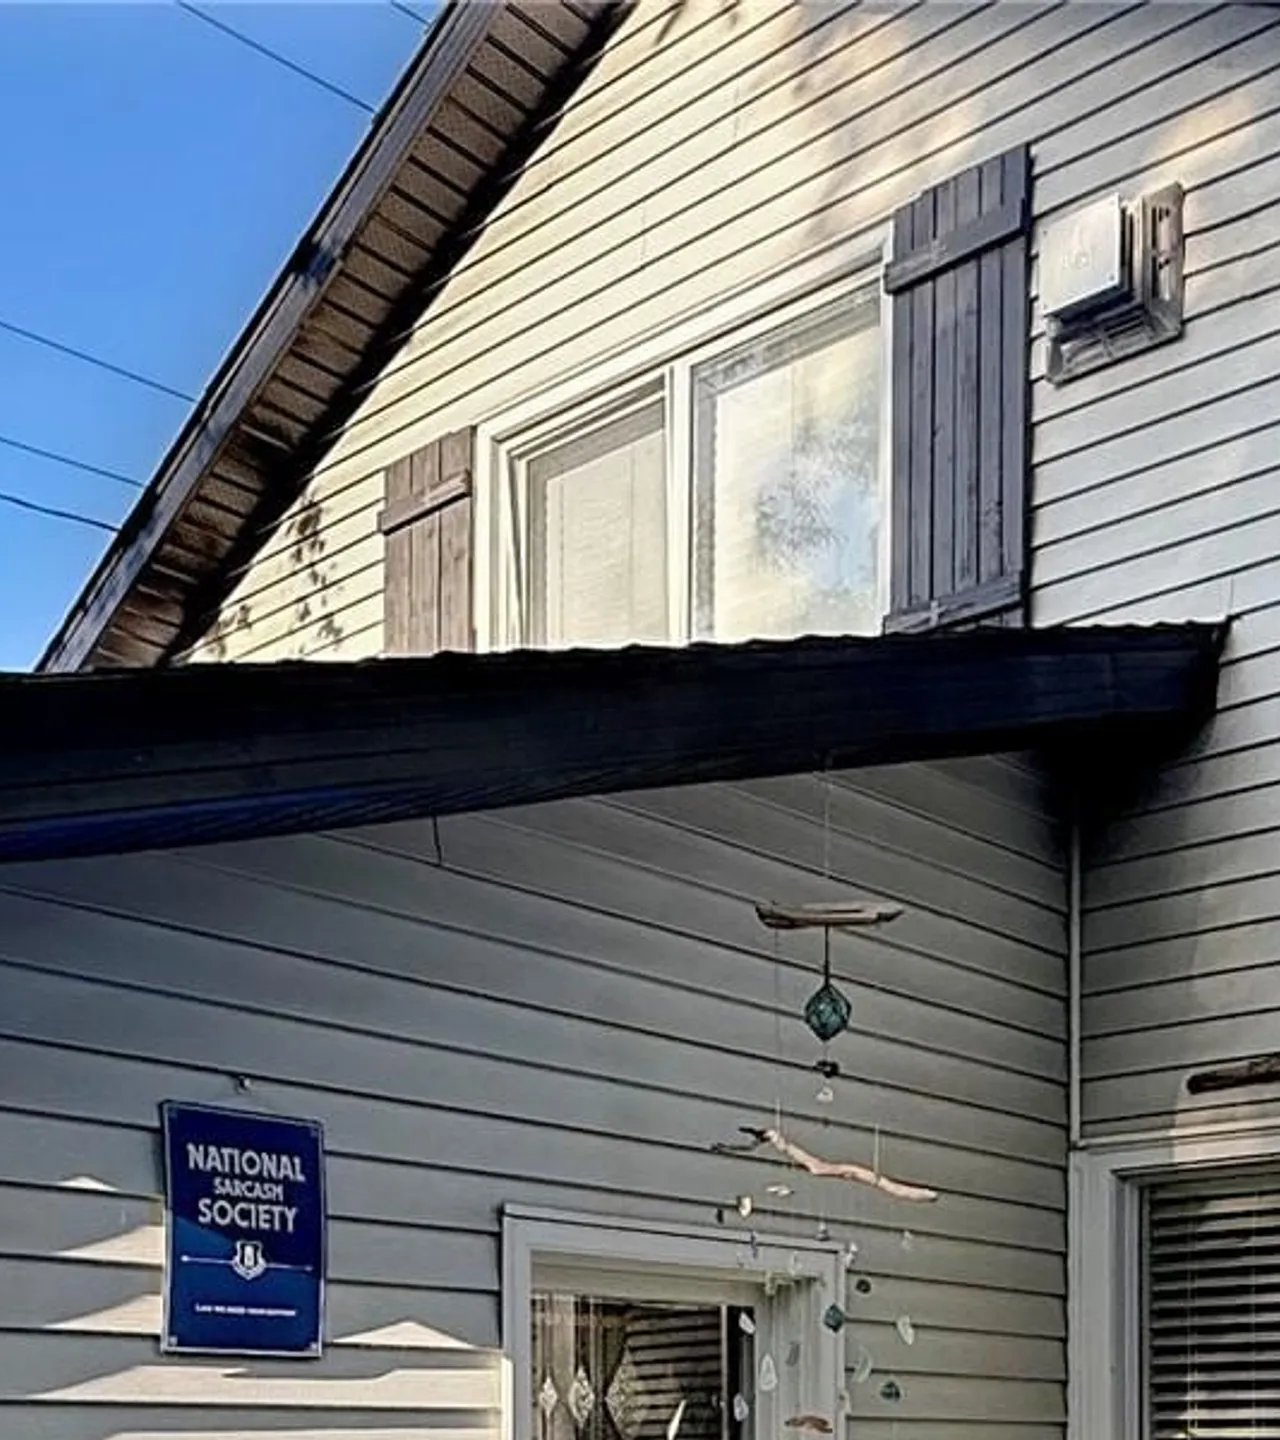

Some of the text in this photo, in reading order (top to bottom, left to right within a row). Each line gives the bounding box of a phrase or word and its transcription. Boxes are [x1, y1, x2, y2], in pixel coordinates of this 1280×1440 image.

[186, 1142, 306, 1182] NATIONAL
[213, 1176, 284, 1202] SARCASM
[197, 1197, 299, 1233] SOCIETY
